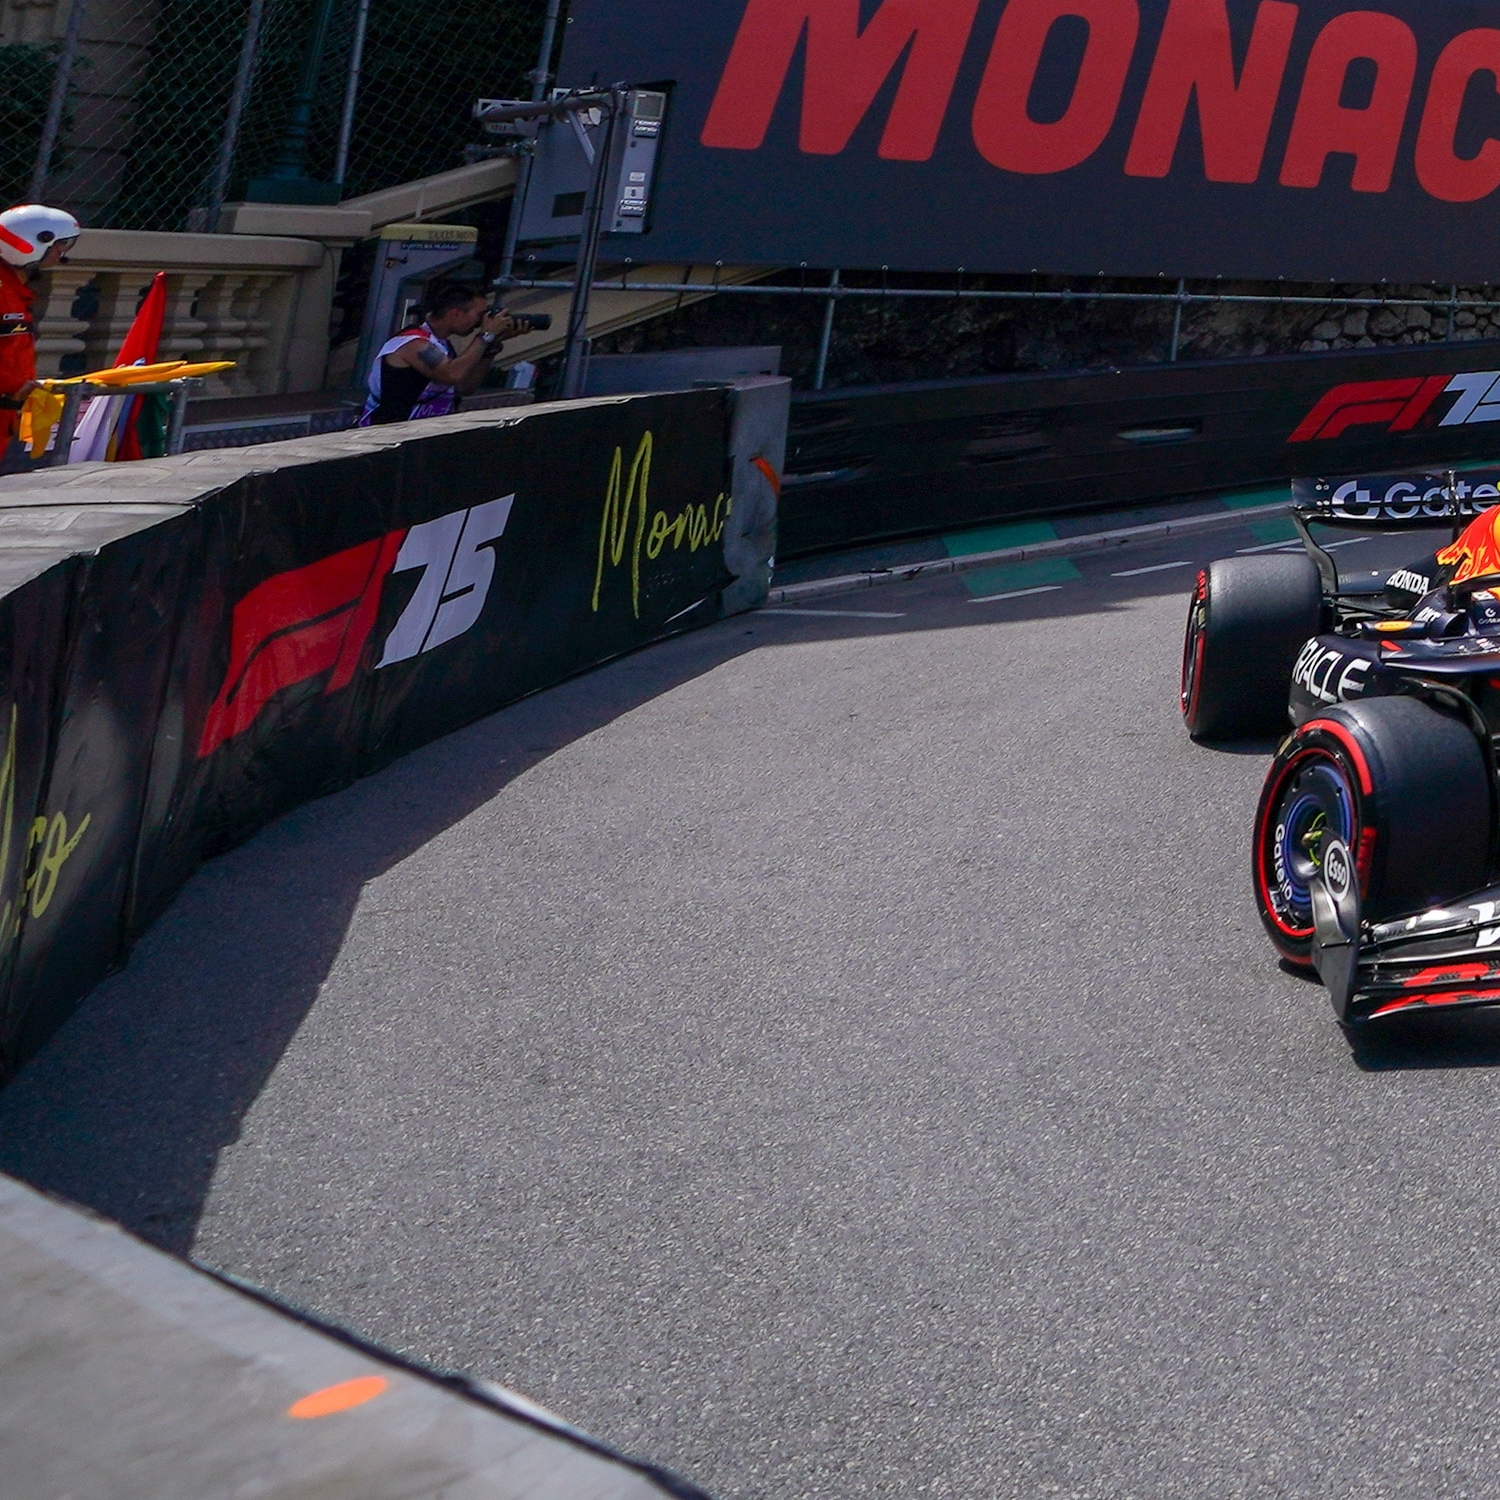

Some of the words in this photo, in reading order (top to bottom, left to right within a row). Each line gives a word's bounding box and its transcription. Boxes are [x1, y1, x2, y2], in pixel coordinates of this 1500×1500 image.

[1286, 374, 1451, 443] F1
[1386, 569, 1430, 596] HONDA
[197, 528, 407, 758] F1
[374, 493, 515, 670] 75
[1292, 636, 1372, 704] RACLE
[1273, 823, 1293, 900] Gate.io
